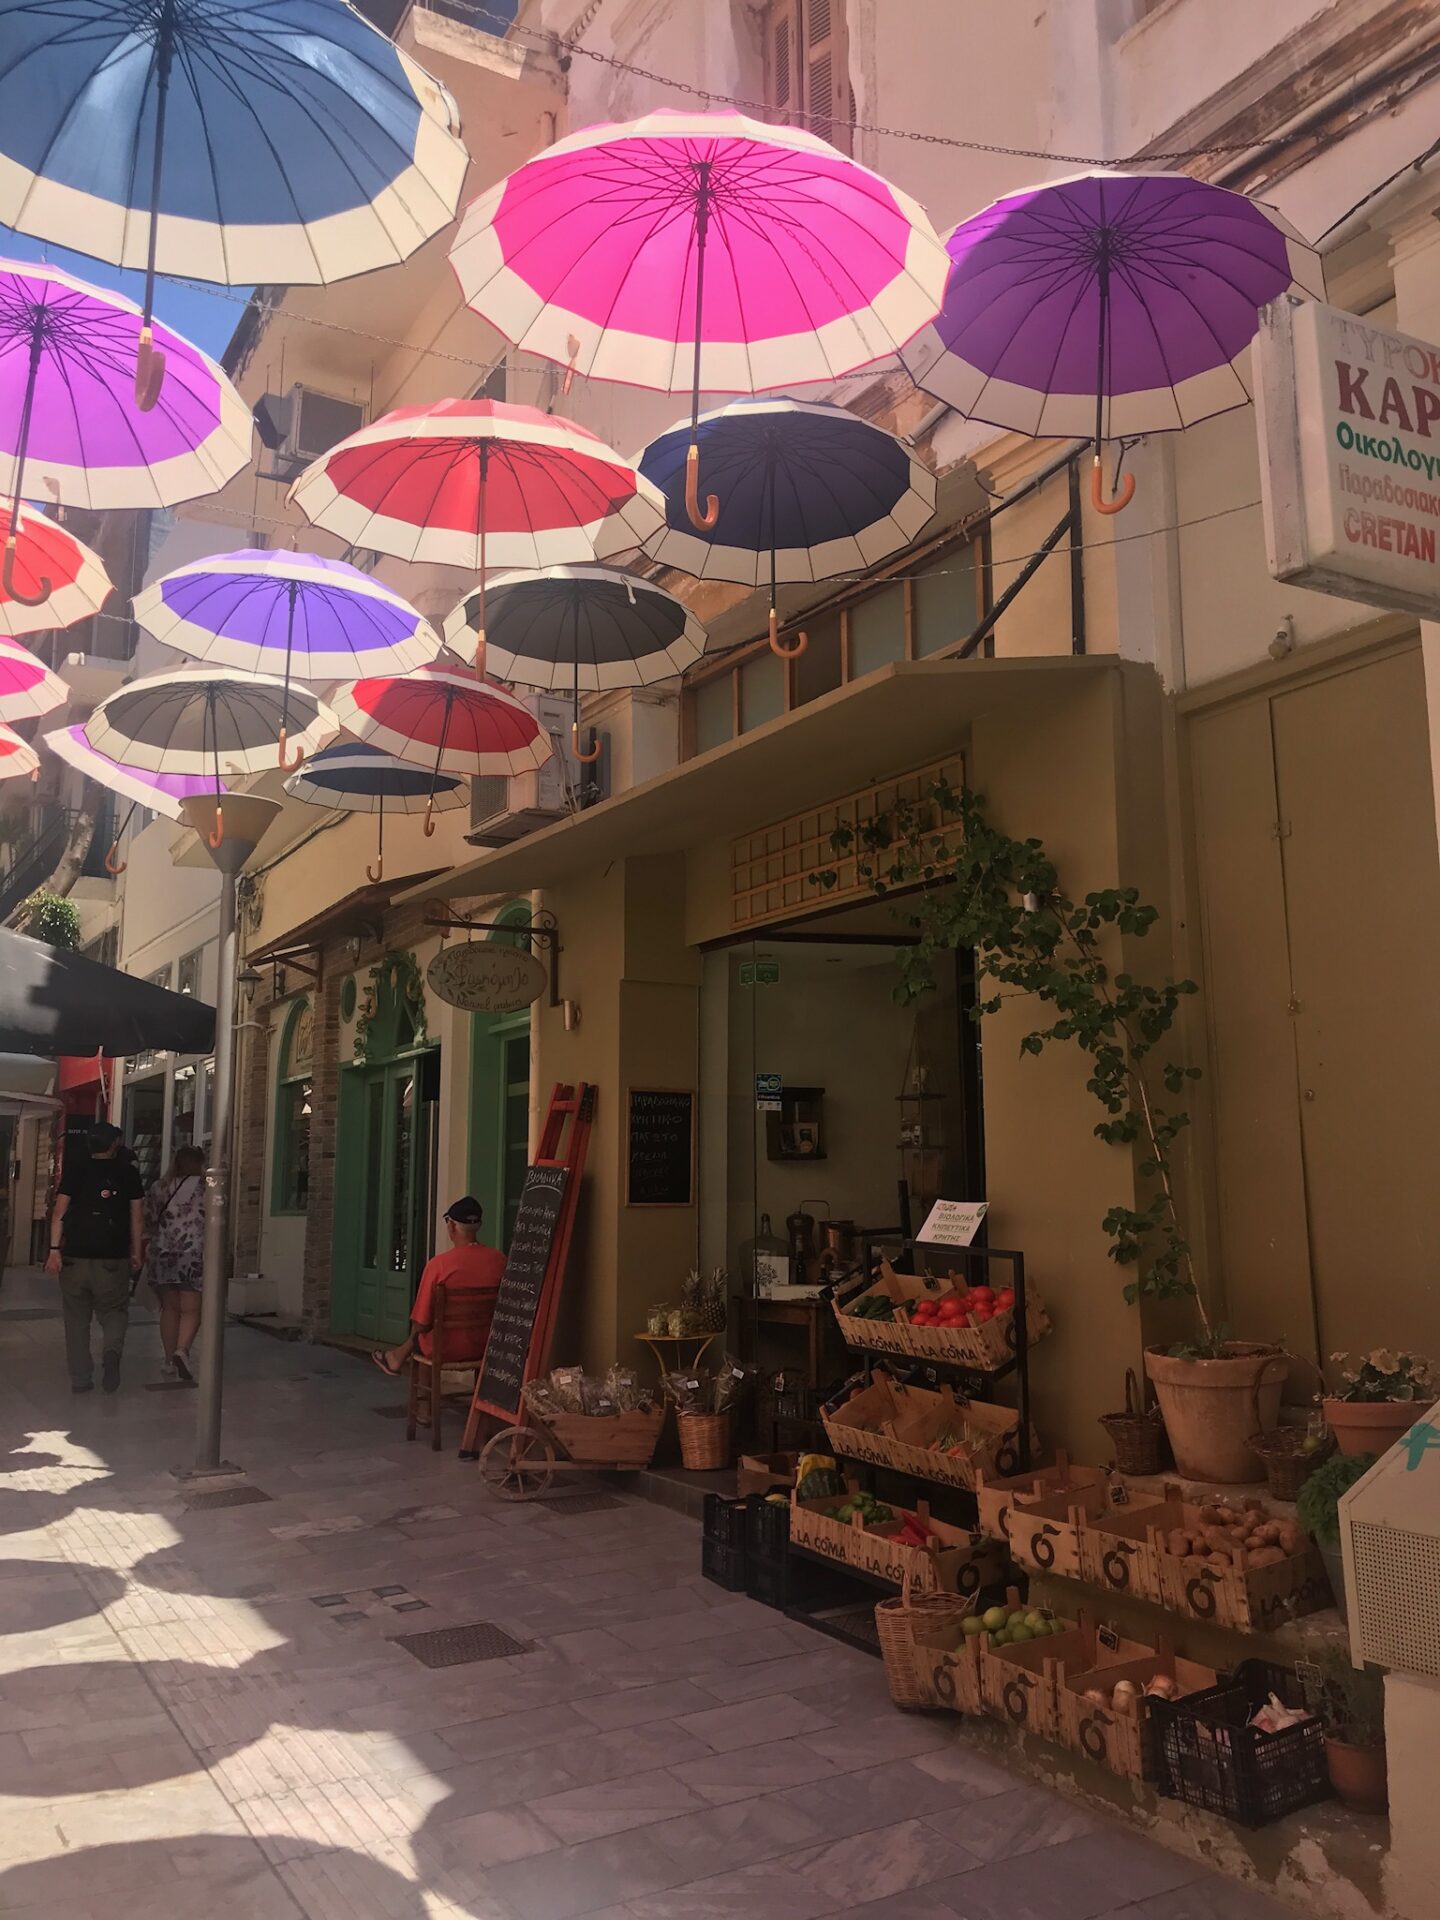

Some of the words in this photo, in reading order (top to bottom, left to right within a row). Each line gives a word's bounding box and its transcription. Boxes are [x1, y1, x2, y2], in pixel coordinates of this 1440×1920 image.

[1338, 462, 1440, 517] Παραδοσιακ
[1343, 507, 1436, 564] CRETAN
[851, 1333, 866, 1345] LA
[920, 1345, 939, 1359] LA
[796, 1529, 811, 1546] LA
[866, 1556, 881, 1575] LA
